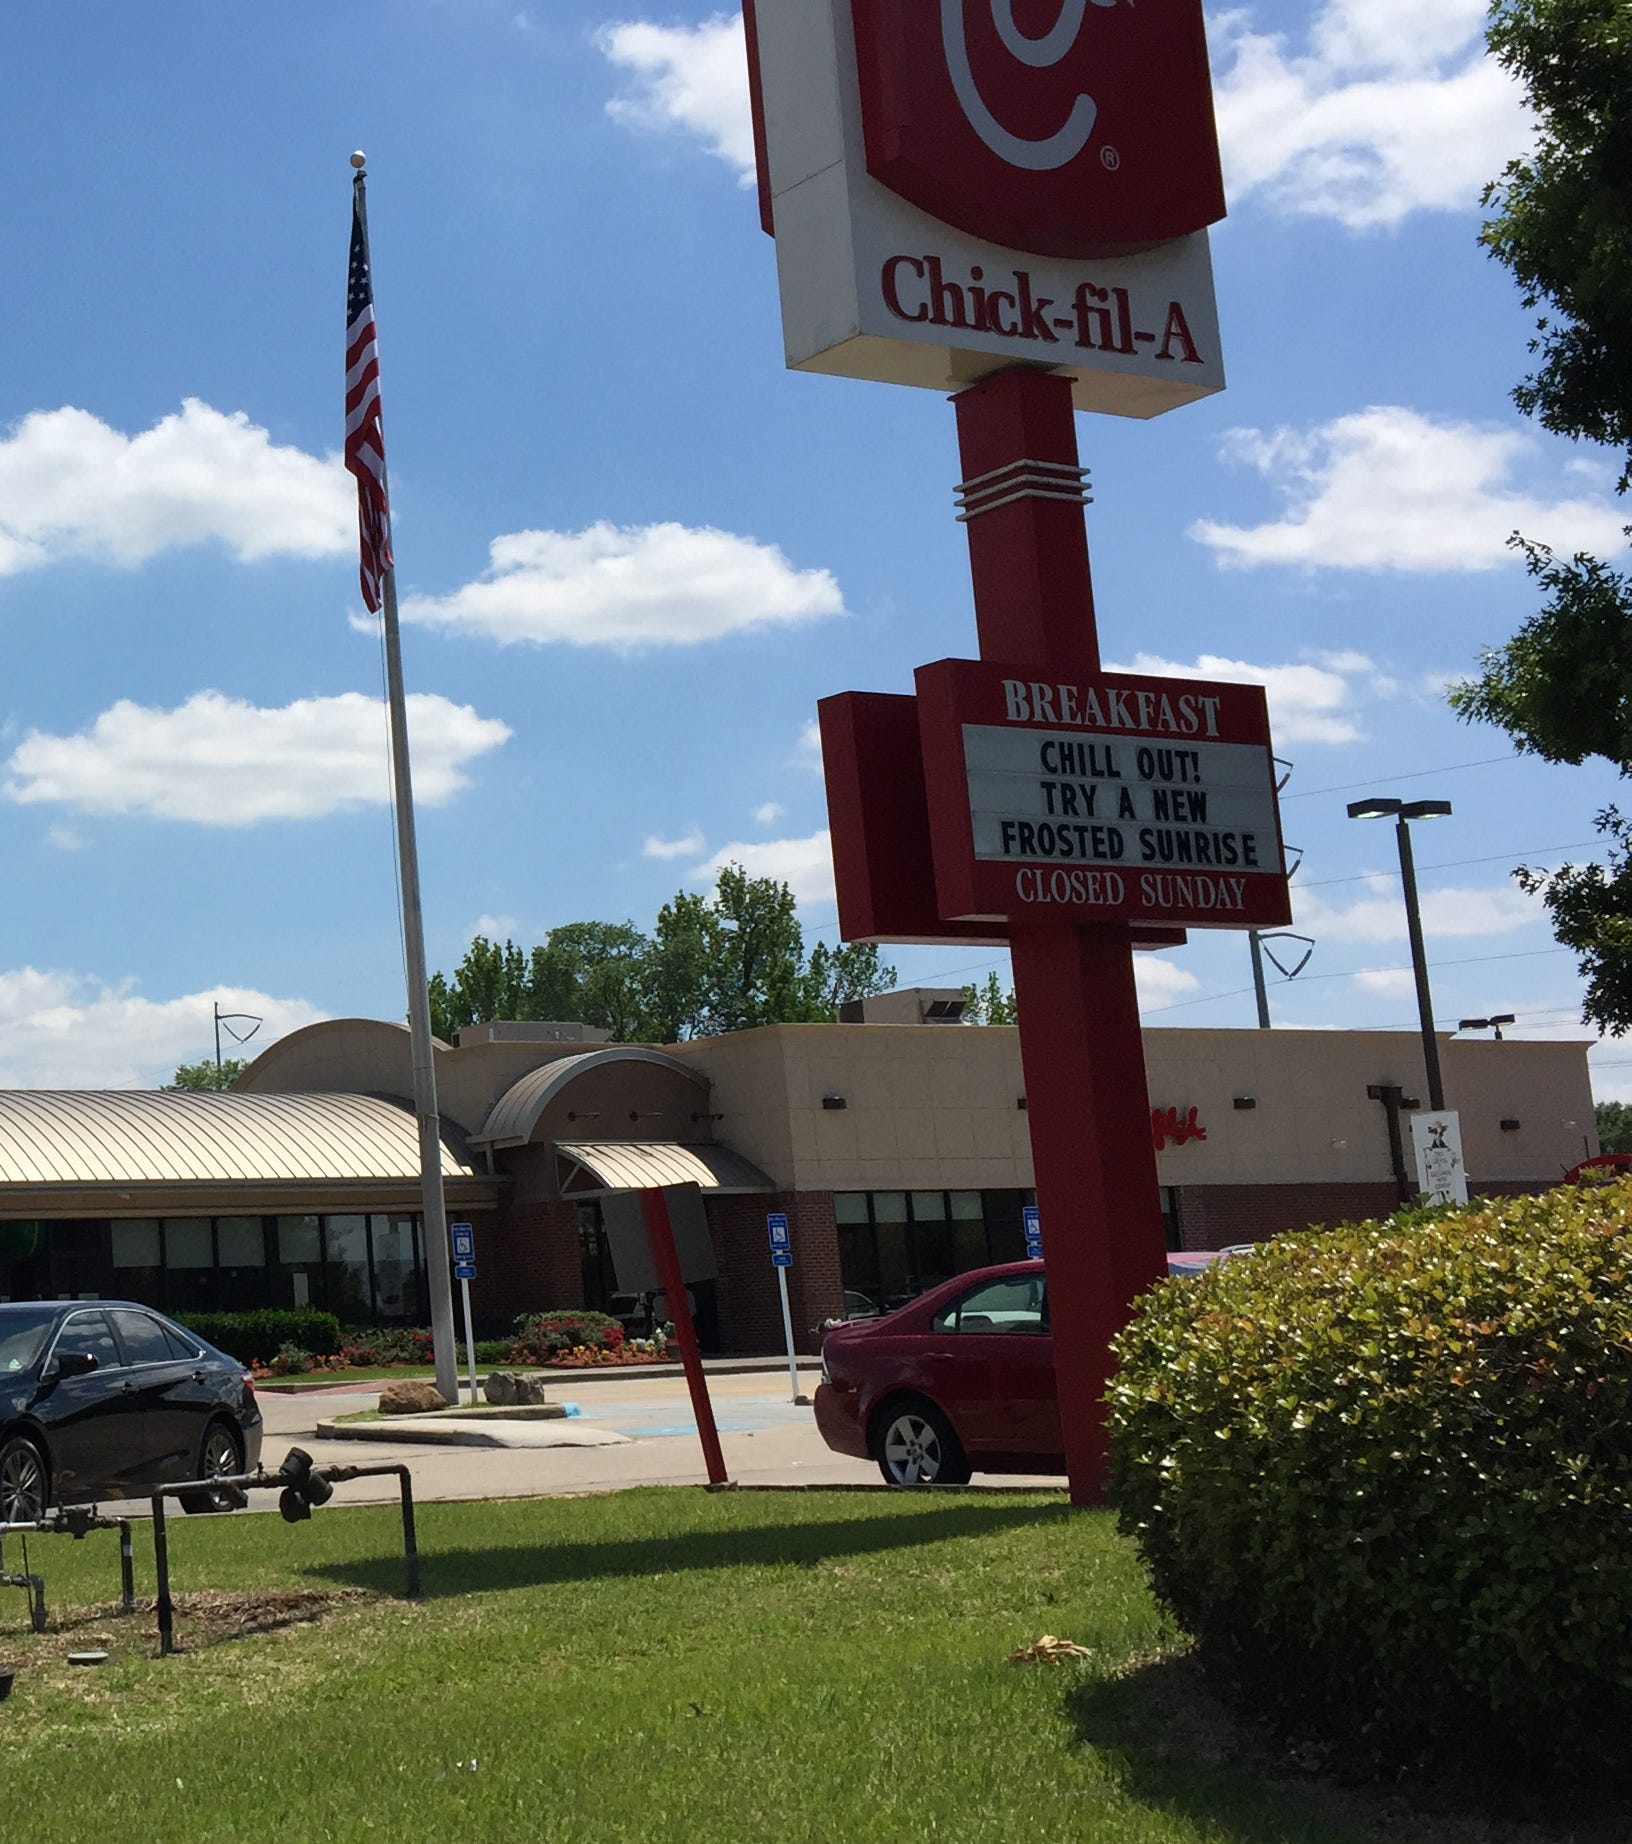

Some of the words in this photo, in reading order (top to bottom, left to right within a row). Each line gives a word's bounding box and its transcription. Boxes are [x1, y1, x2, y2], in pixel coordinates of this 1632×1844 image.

[880, 255, 1204, 365] Chick-fil-A
[1001, 679, 1221, 737] BREAKFAST
[1040, 741, 1121, 778] CHILL
[1137, 746, 1200, 783] OUT!
[1040, 781, 1097, 818] TRY
[1118, 786, 1136, 820] A
[1154, 789, 1207, 824] NEW
[1001, 821, 1124, 860] FROSTED
[1139, 827, 1258, 867] SUNRISE
[1016, 868, 1125, 905] CLOSED
[1141, 873, 1246, 910] SUNDAY
